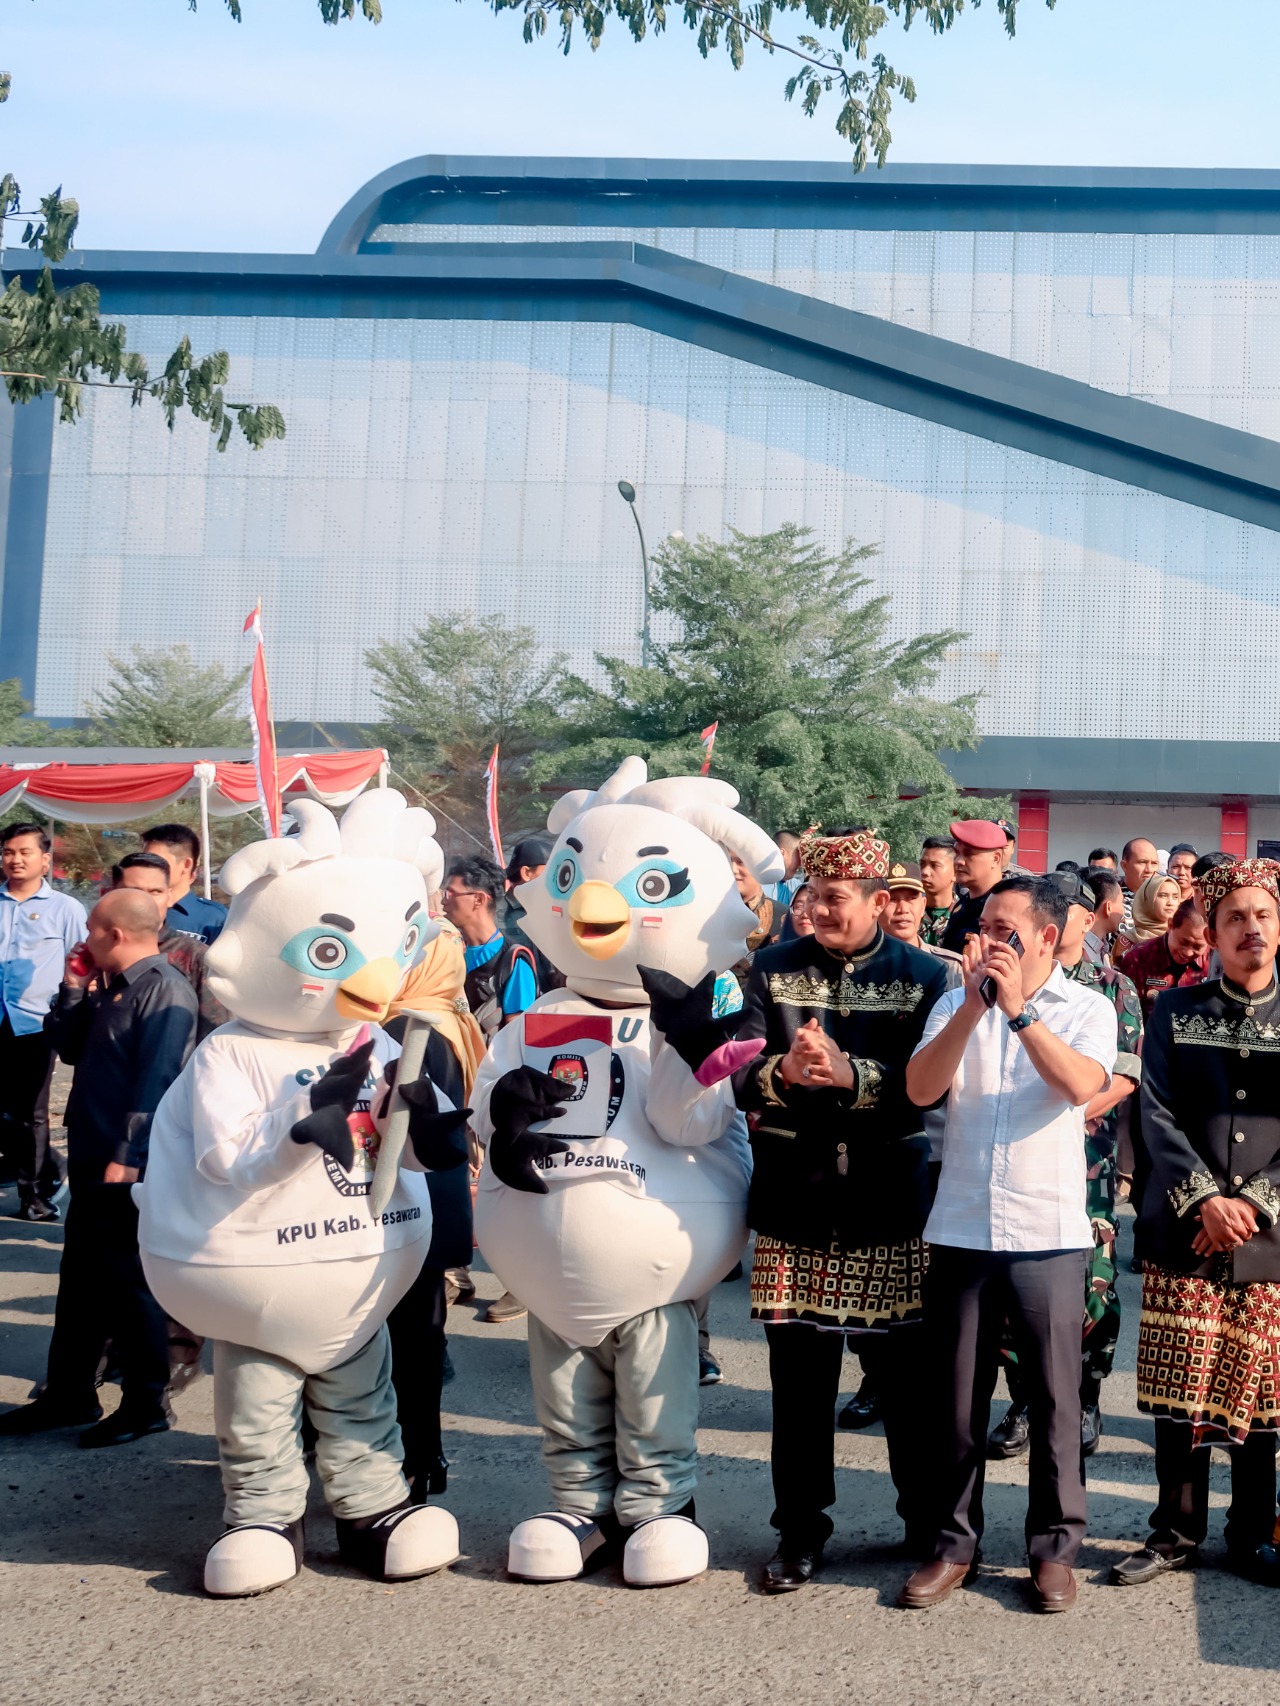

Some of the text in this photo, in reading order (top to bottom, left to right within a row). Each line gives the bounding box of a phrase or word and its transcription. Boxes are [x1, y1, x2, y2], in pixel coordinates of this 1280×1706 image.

[564, 1151, 646, 1181] Pesawaran
[277, 1222, 317, 1245] KPU
[323, 1214, 367, 1236] Kab.
